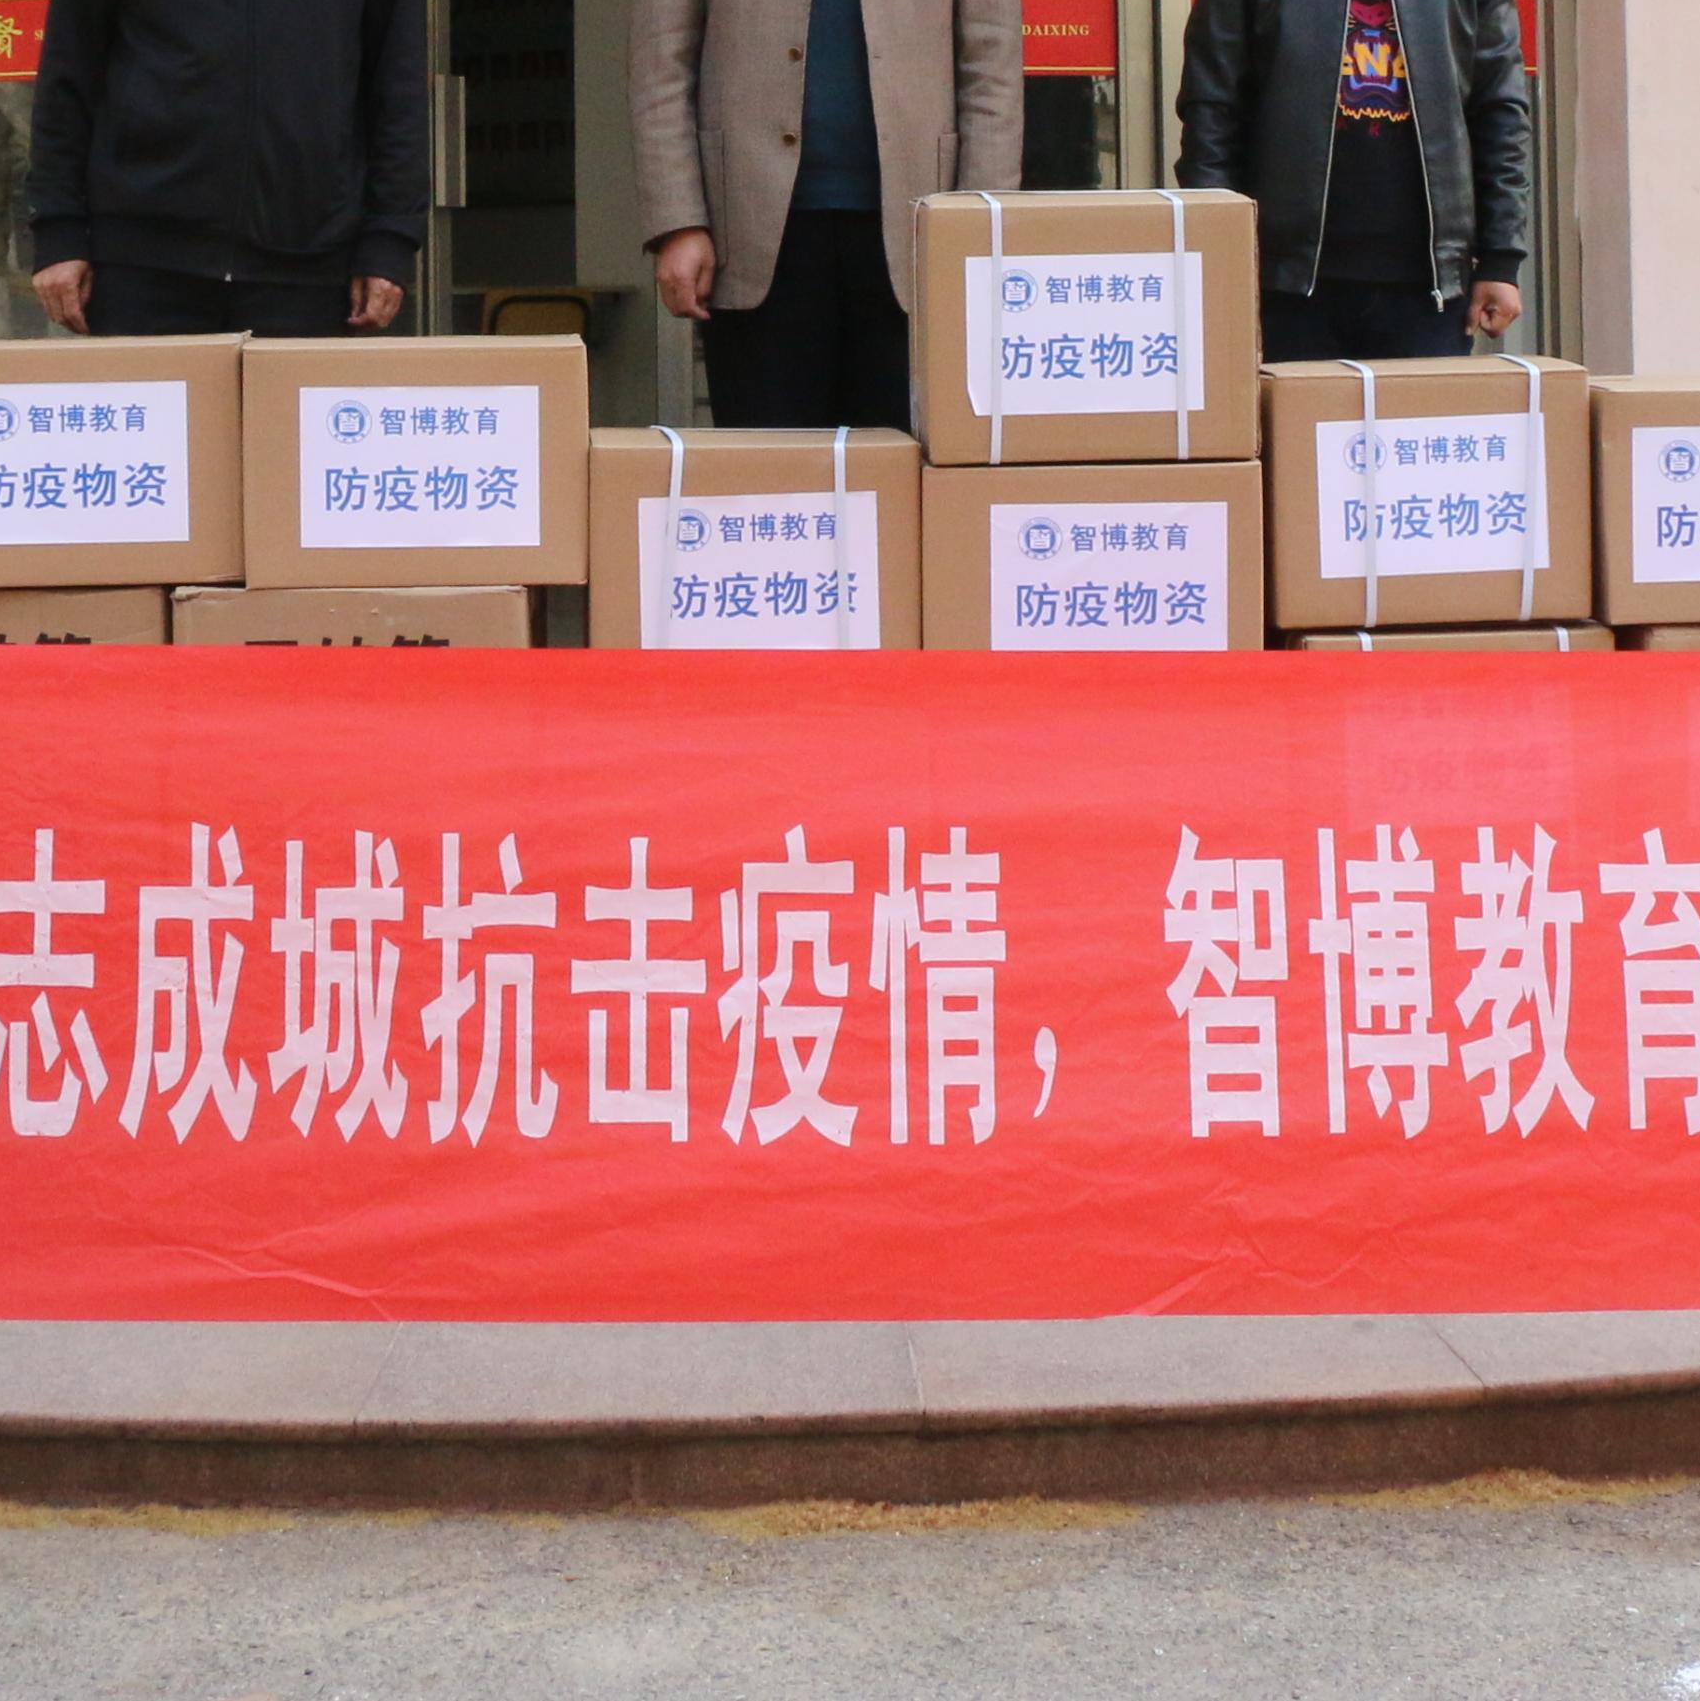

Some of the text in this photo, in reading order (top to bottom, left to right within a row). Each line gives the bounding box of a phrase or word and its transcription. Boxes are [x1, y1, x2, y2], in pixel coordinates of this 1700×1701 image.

[1021, 23, 1090, 37] DAIXING
[1045, 273, 1164, 304] 智博教育
[1001, 331, 1179, 381] 防疫物资
[27, 403, 148, 434] 智博教育
[379, 405, 500, 437] 智博教育
[1394, 433, 1507, 466] 智博教育
[323, 463, 520, 513] 防疫物资
[718, 511, 838, 544] 智博教育
[1342, 491, 1529, 542] 防疫物资
[1069, 522, 1190, 552] 智博教育
[670, 570, 859, 621] 防疫物资
[1015, 580, 1208, 628] 防疫物资
